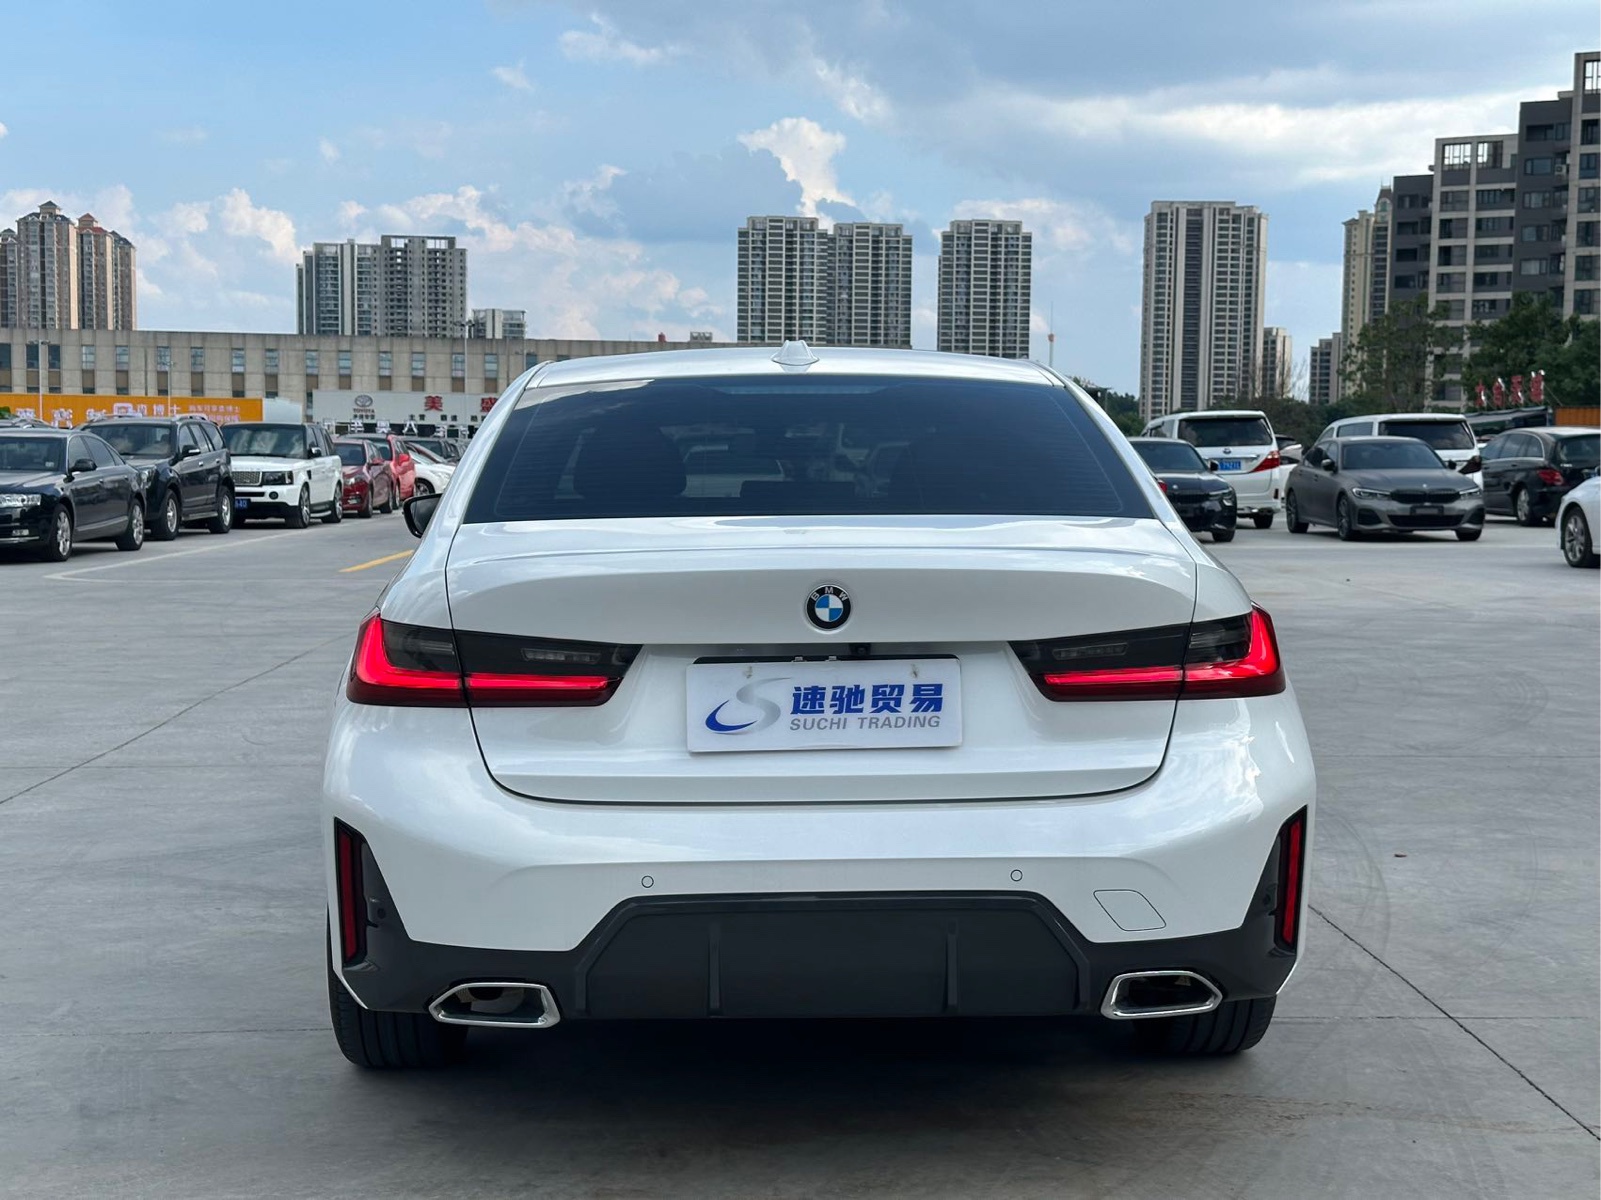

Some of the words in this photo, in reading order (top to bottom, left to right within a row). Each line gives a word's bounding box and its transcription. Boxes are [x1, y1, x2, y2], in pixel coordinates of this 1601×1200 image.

[811, 586, 848, 601] BMW
[790, 683, 944, 715] 速驰贸易
[790, 717, 848, 731] SUCHI
[858, 715, 941, 730] TRADING
